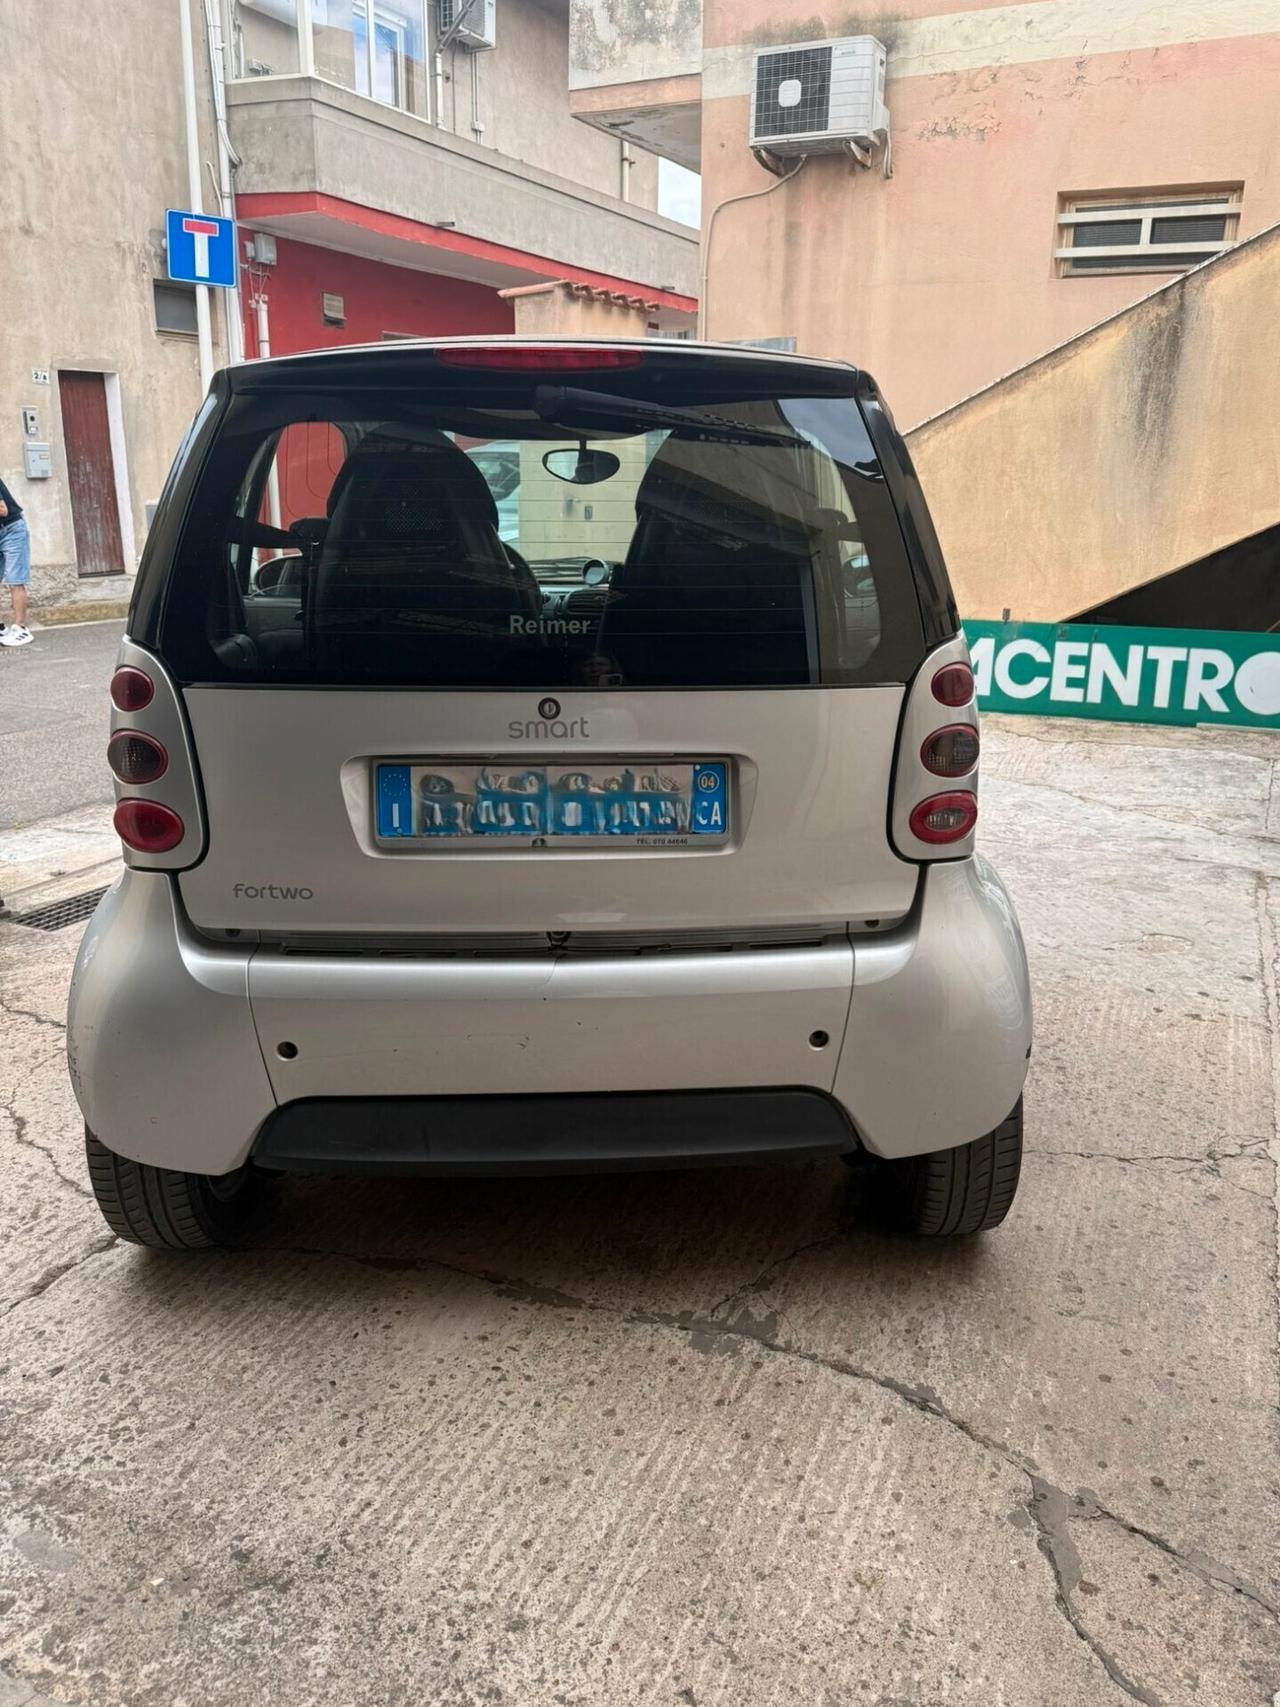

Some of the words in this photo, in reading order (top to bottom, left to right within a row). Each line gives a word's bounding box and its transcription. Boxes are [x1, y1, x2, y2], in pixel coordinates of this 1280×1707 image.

[509, 614, 591, 634] Reimer
[508, 716, 590, 739] smart
[701, 775, 715, 788] 04
[696, 801, 722, 825] CA
[232, 883, 314, 900] fortwo
